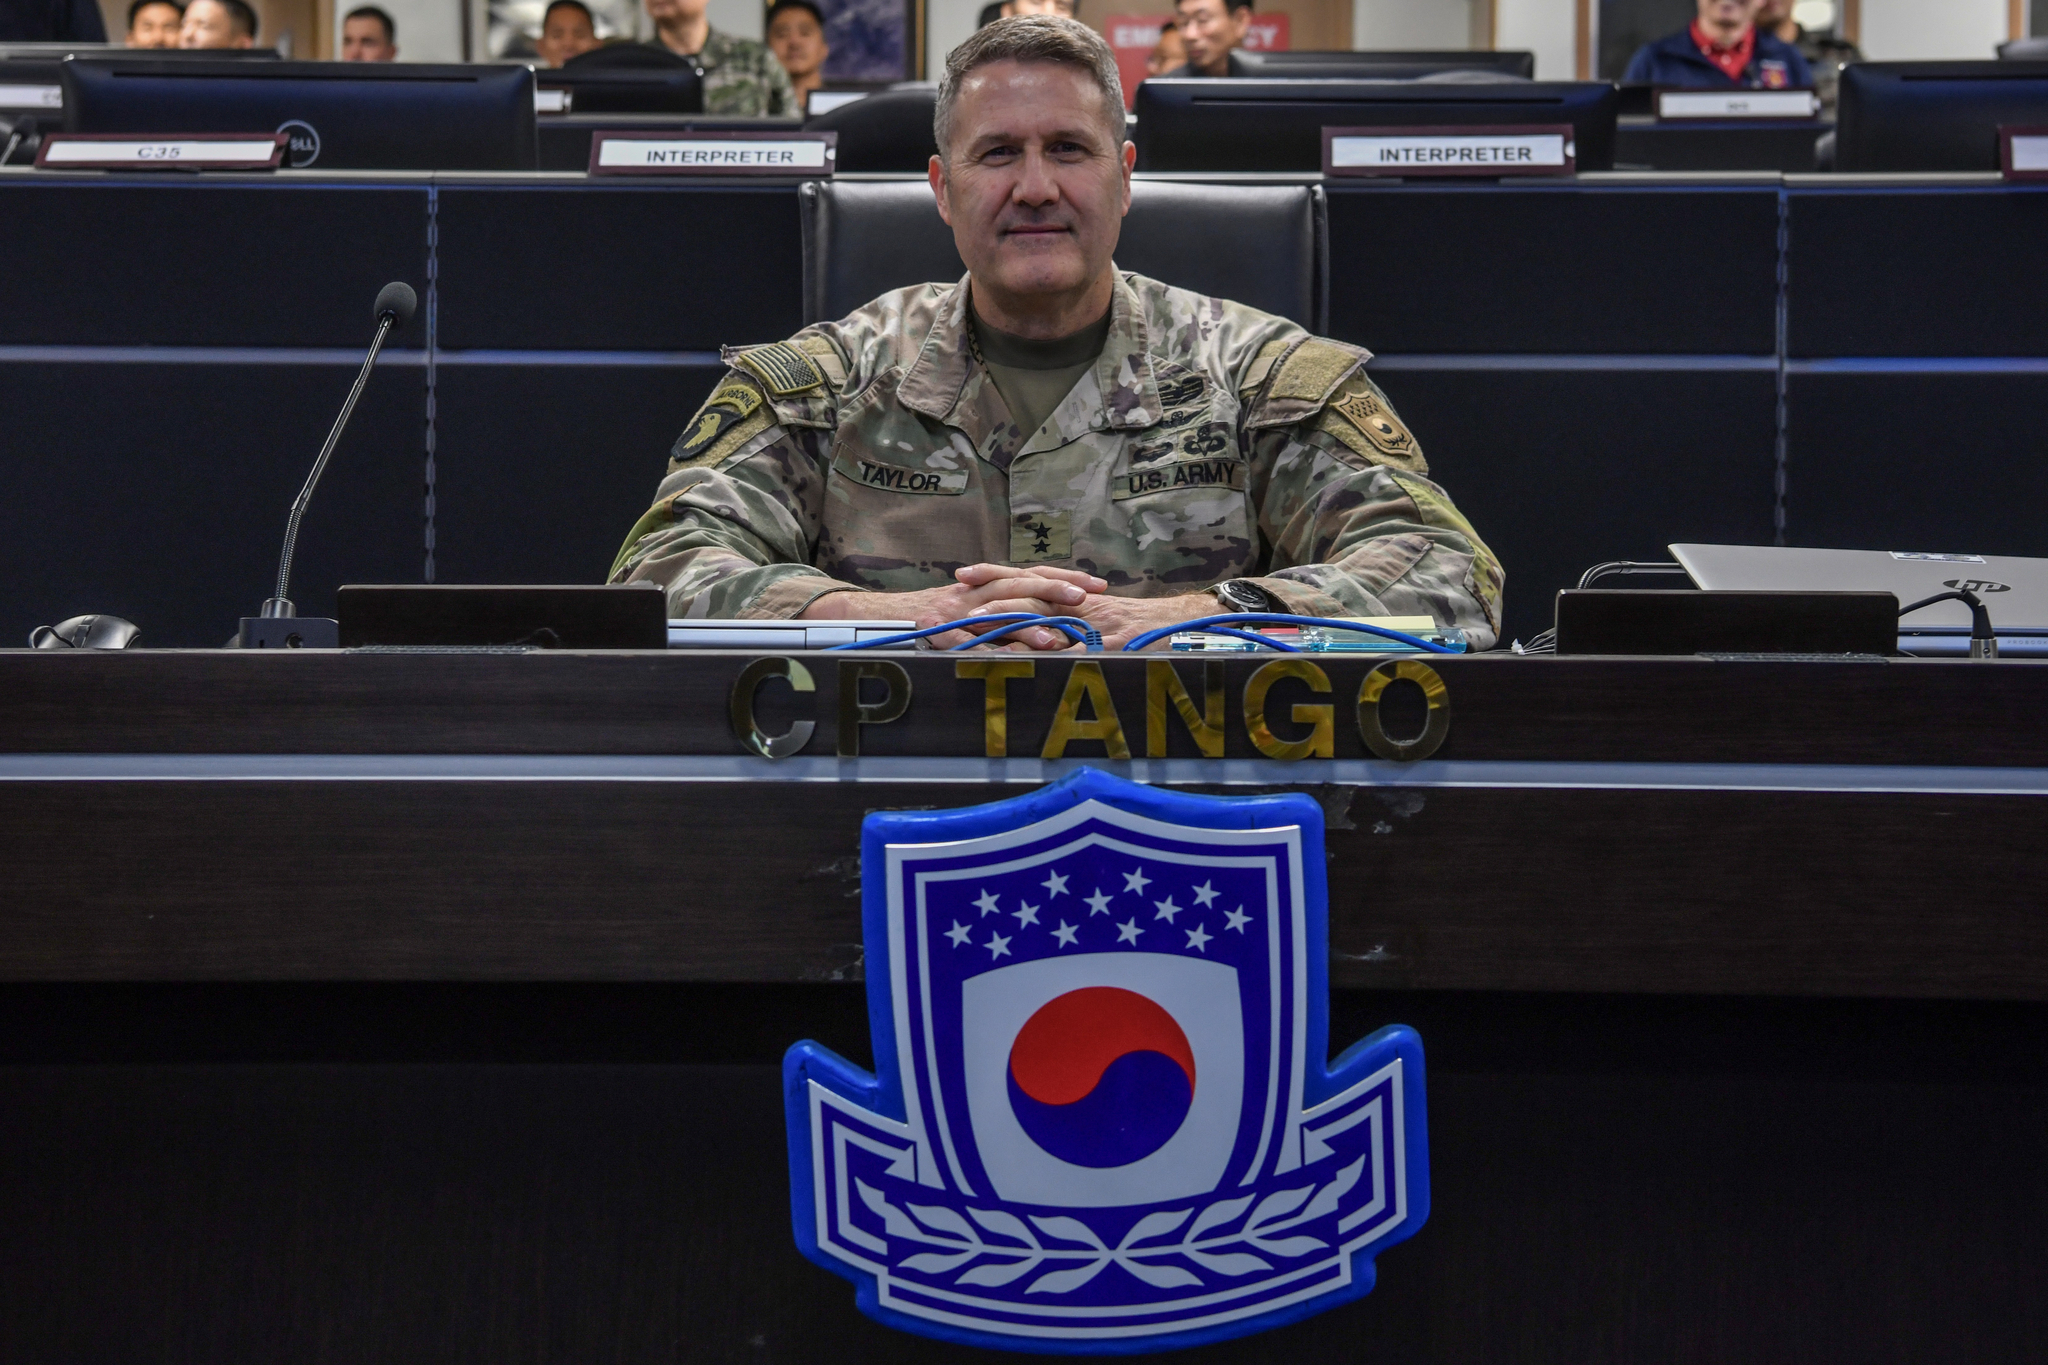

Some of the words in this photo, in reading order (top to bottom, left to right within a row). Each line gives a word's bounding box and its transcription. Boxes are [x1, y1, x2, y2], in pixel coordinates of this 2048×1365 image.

[138, 146, 181, 158] C35
[646, 150, 794, 164] INTERPRETER
[1380, 147, 1532, 162] INTERPRETER
[861, 461, 942, 491] TAYLOR
[1129, 471, 1168, 494] U.S.
[1173, 461, 1236, 486] ARMY
[729, 656, 914, 759] CP
[955, 657, 1451, 761] TANGO
